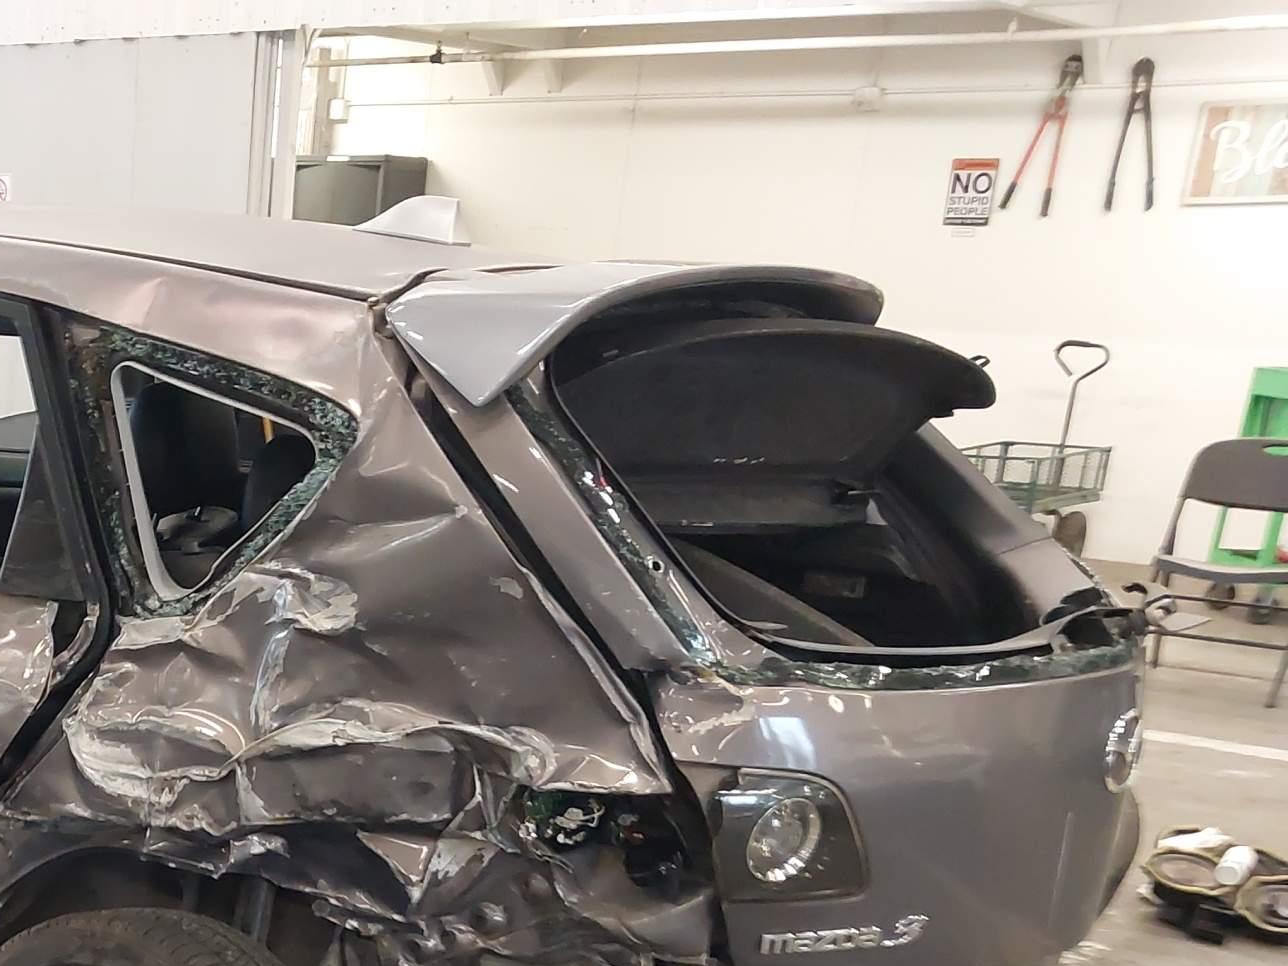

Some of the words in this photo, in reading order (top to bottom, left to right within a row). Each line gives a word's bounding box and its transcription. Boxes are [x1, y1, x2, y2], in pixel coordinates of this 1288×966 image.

[951, 172, 993, 194] NO
[948, 196, 989, 206] STUPID
[946, 207, 988, 216] PEOPLE
